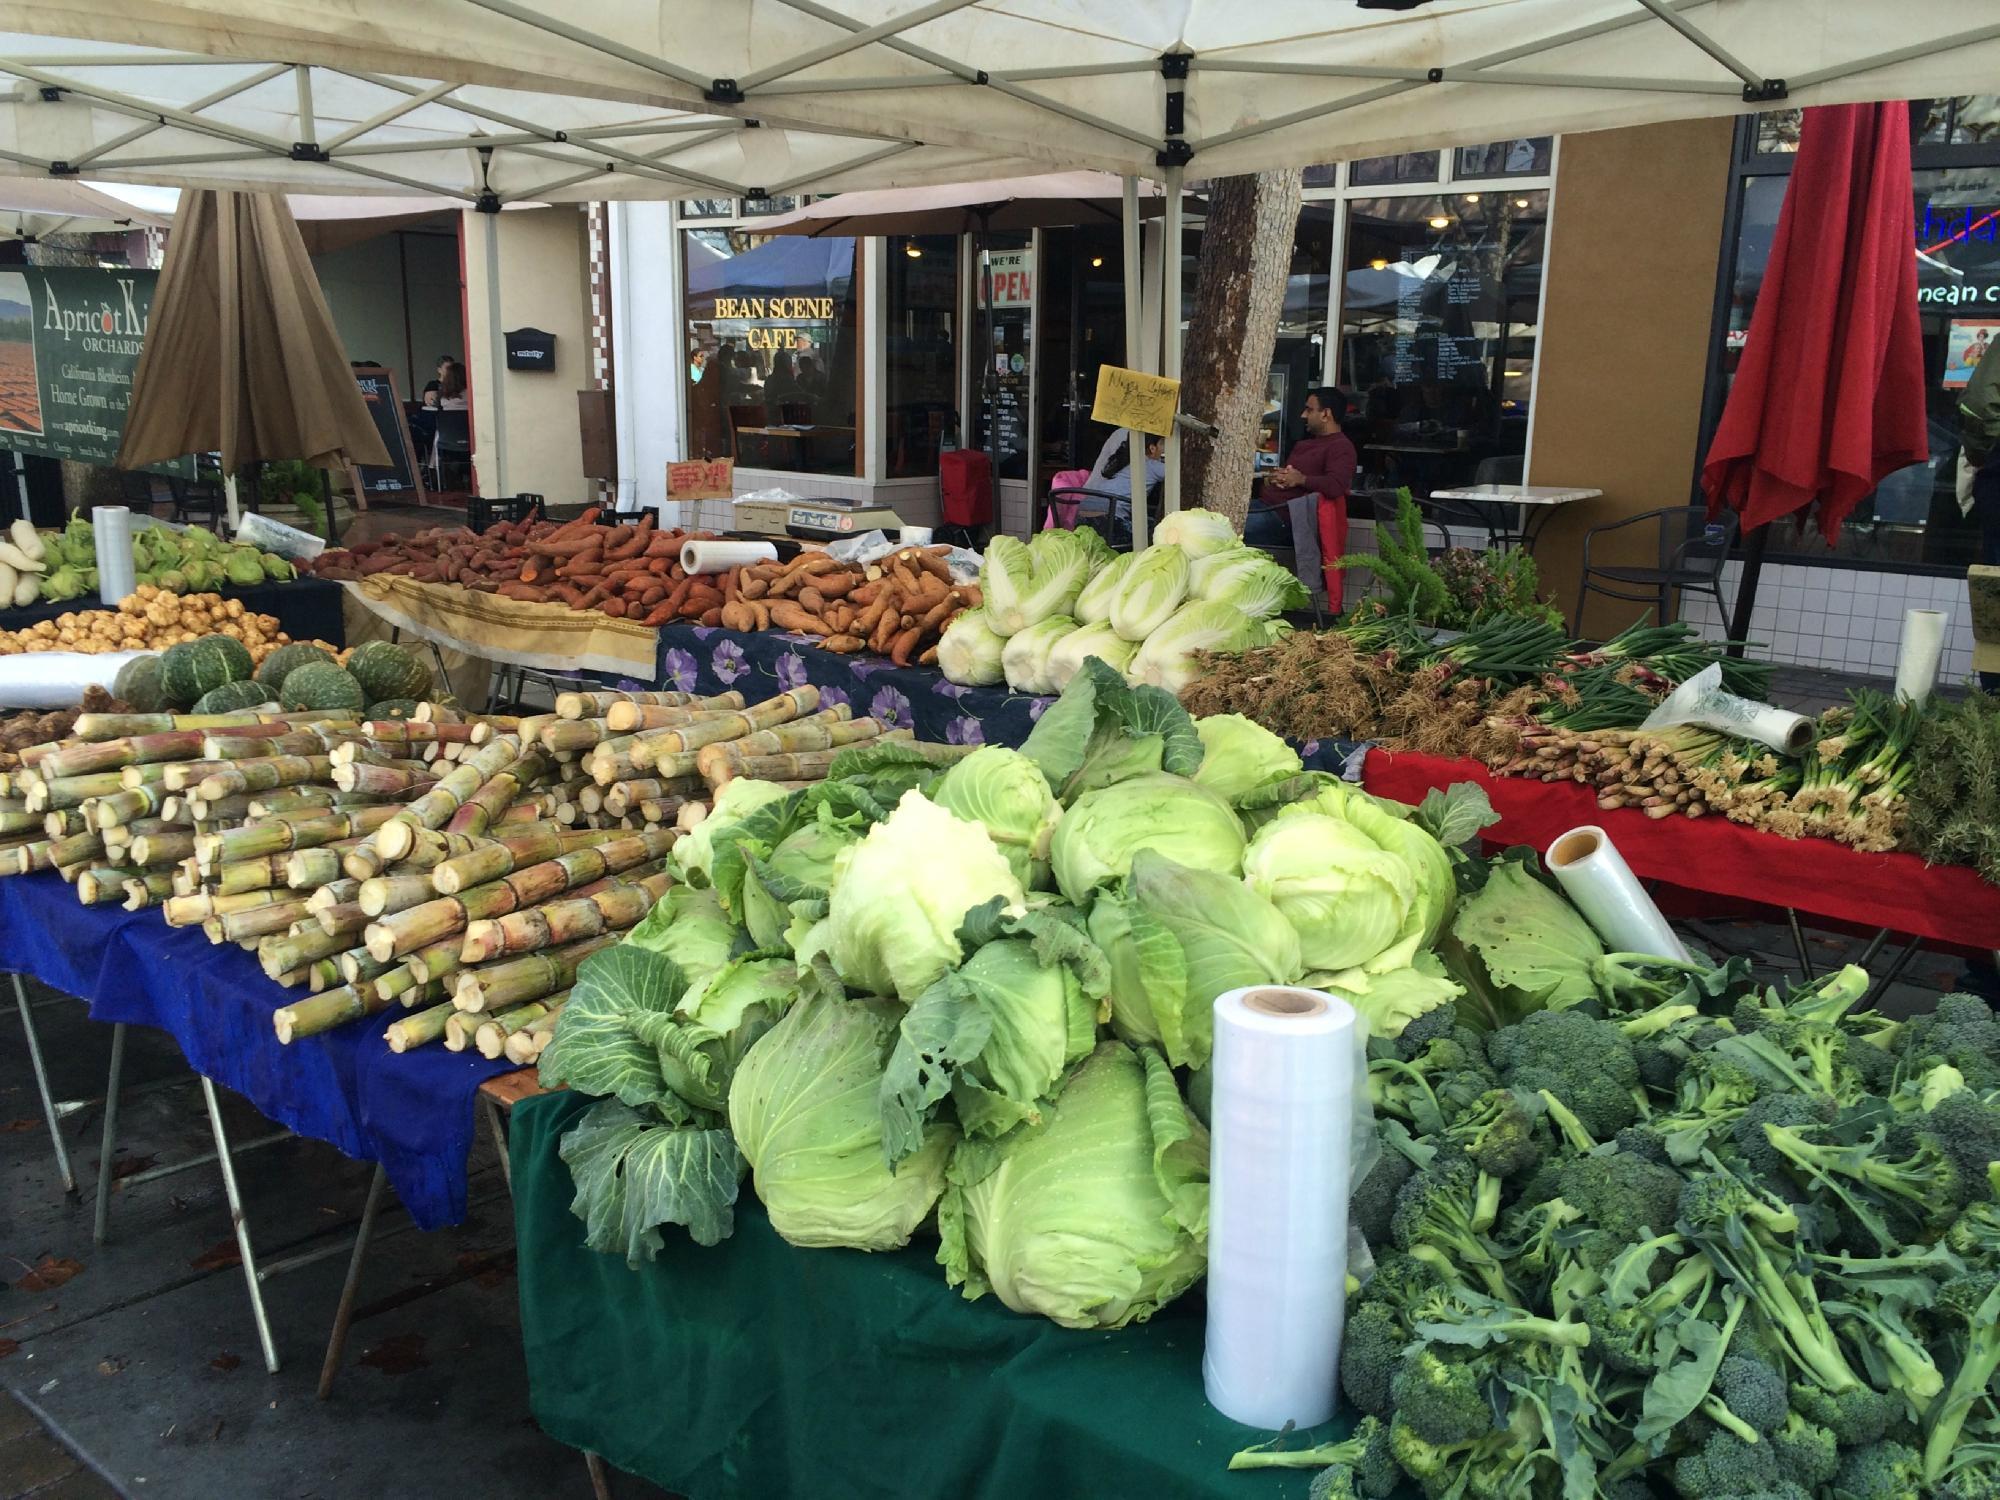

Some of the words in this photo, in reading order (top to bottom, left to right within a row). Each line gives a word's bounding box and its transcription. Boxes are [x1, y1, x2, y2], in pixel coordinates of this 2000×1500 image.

[1915, 204, 1997, 246] hda
[991, 256, 1021, 266] WE'RE
[43, 277, 122, 341] Apricot
[715, 297, 765, 319] BEAN
[769, 297, 834, 319] SCENE
[82, 337, 145, 355] ORCHARDS
[747, 328, 798, 350] CAFE
[50, 384, 78, 405] Home
[78, 387, 108, 409] Grown
